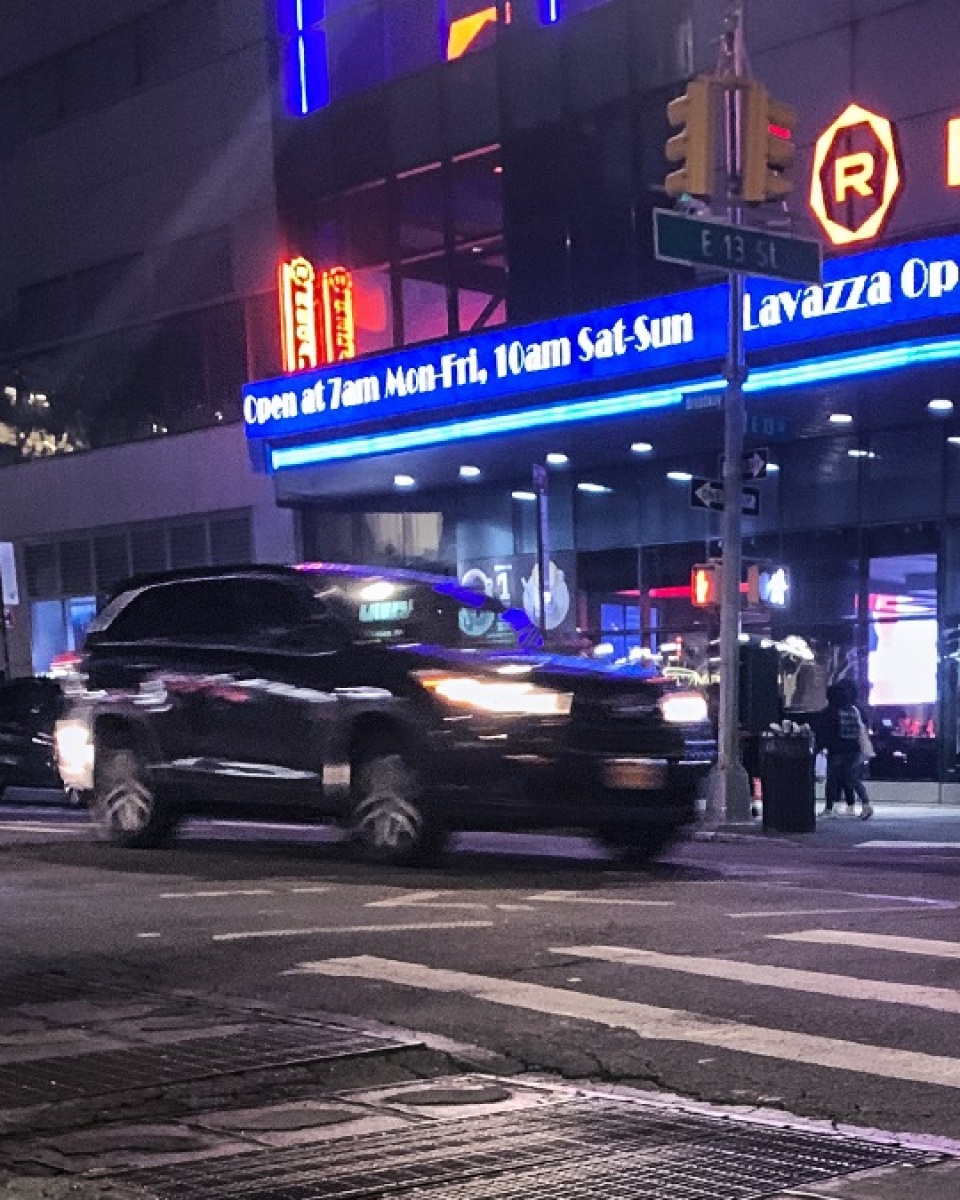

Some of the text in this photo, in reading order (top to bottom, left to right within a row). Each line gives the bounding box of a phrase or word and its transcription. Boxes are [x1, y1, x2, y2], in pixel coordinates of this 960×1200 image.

[835, 152, 875, 202] R
[701, 229, 778, 268] E 13 St
[742, 270, 892, 331] Lavazza
[243, 312, 695, 425] Open at 7am Mon-Fri, 10am Sat-Sun
